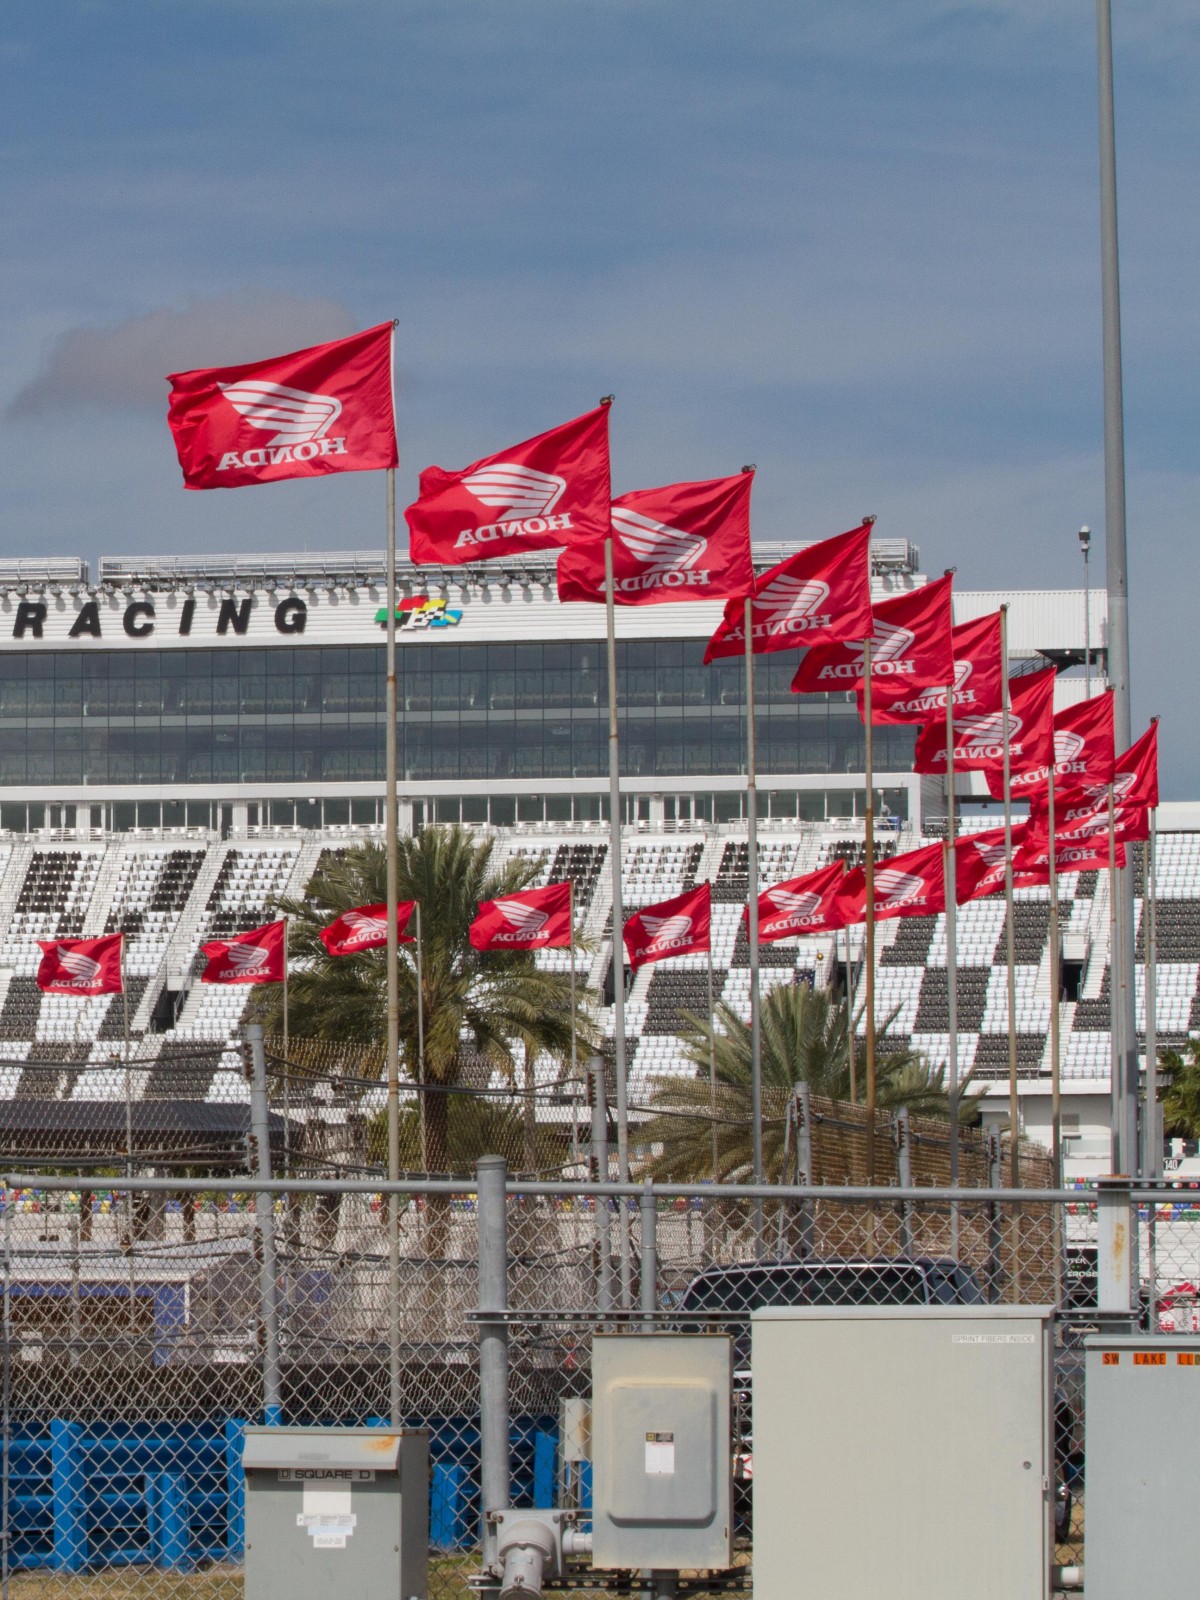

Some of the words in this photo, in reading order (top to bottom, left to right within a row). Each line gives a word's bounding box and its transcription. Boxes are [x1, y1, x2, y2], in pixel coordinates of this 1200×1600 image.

[12, 597, 308, 638] RACING
[1164, 1159, 1178, 1171] 140
[1104, 1353, 1119, 1364] SW
[1135, 1353, 1166, 1365] LAKE
[294, 1470, 353, 1479] SQUARE
[359, 1470, 371, 1479] D
